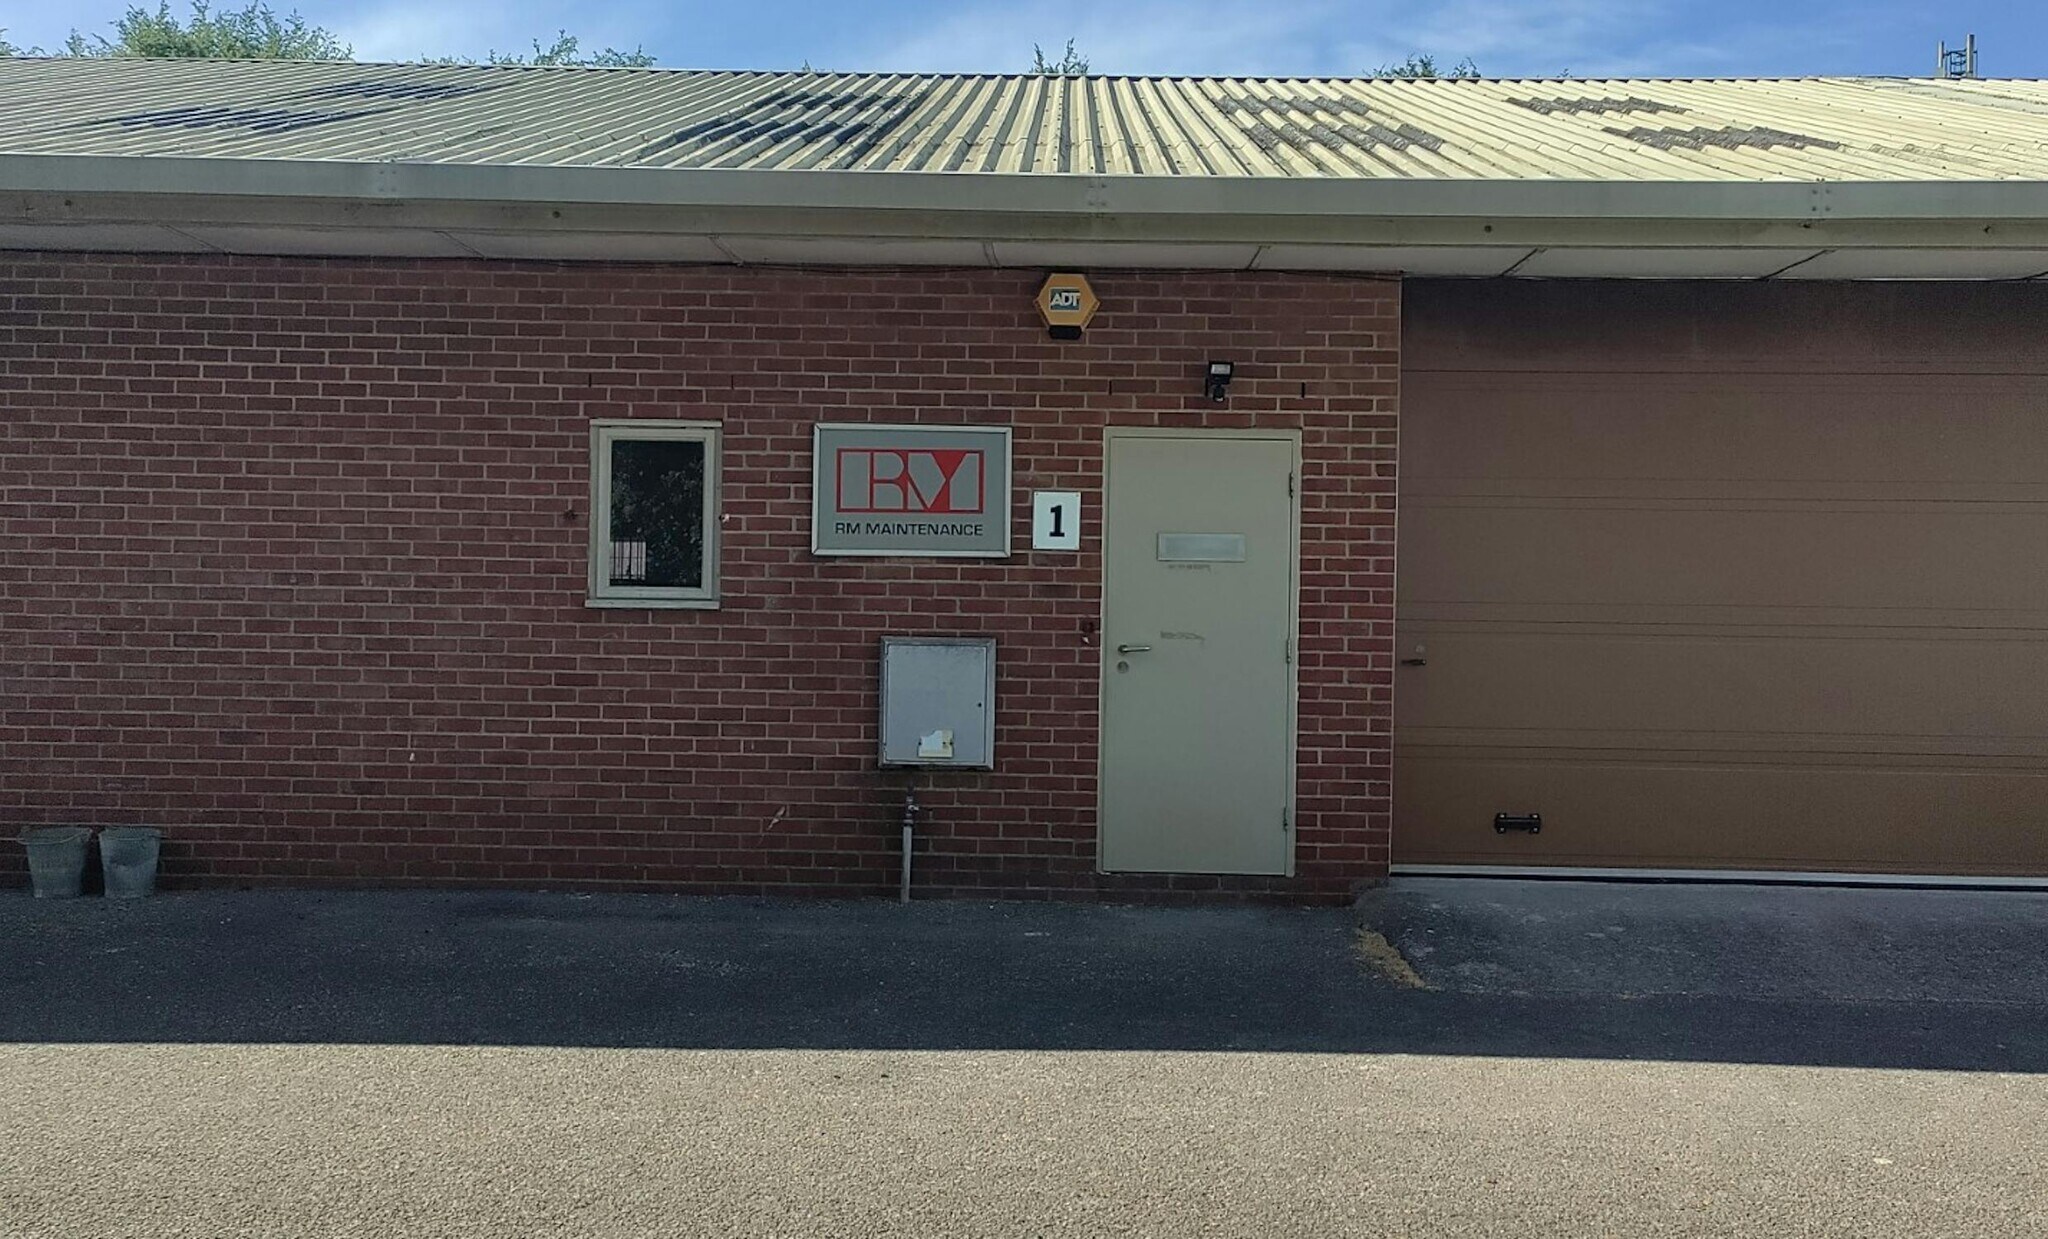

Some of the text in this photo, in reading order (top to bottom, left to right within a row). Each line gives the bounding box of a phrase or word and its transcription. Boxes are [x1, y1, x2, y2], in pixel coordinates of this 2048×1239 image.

[1050, 292, 1081, 307] ADT
[1049, 504, 1065, 538] 1
[835, 523, 983, 536] RM MAINTENANCE
